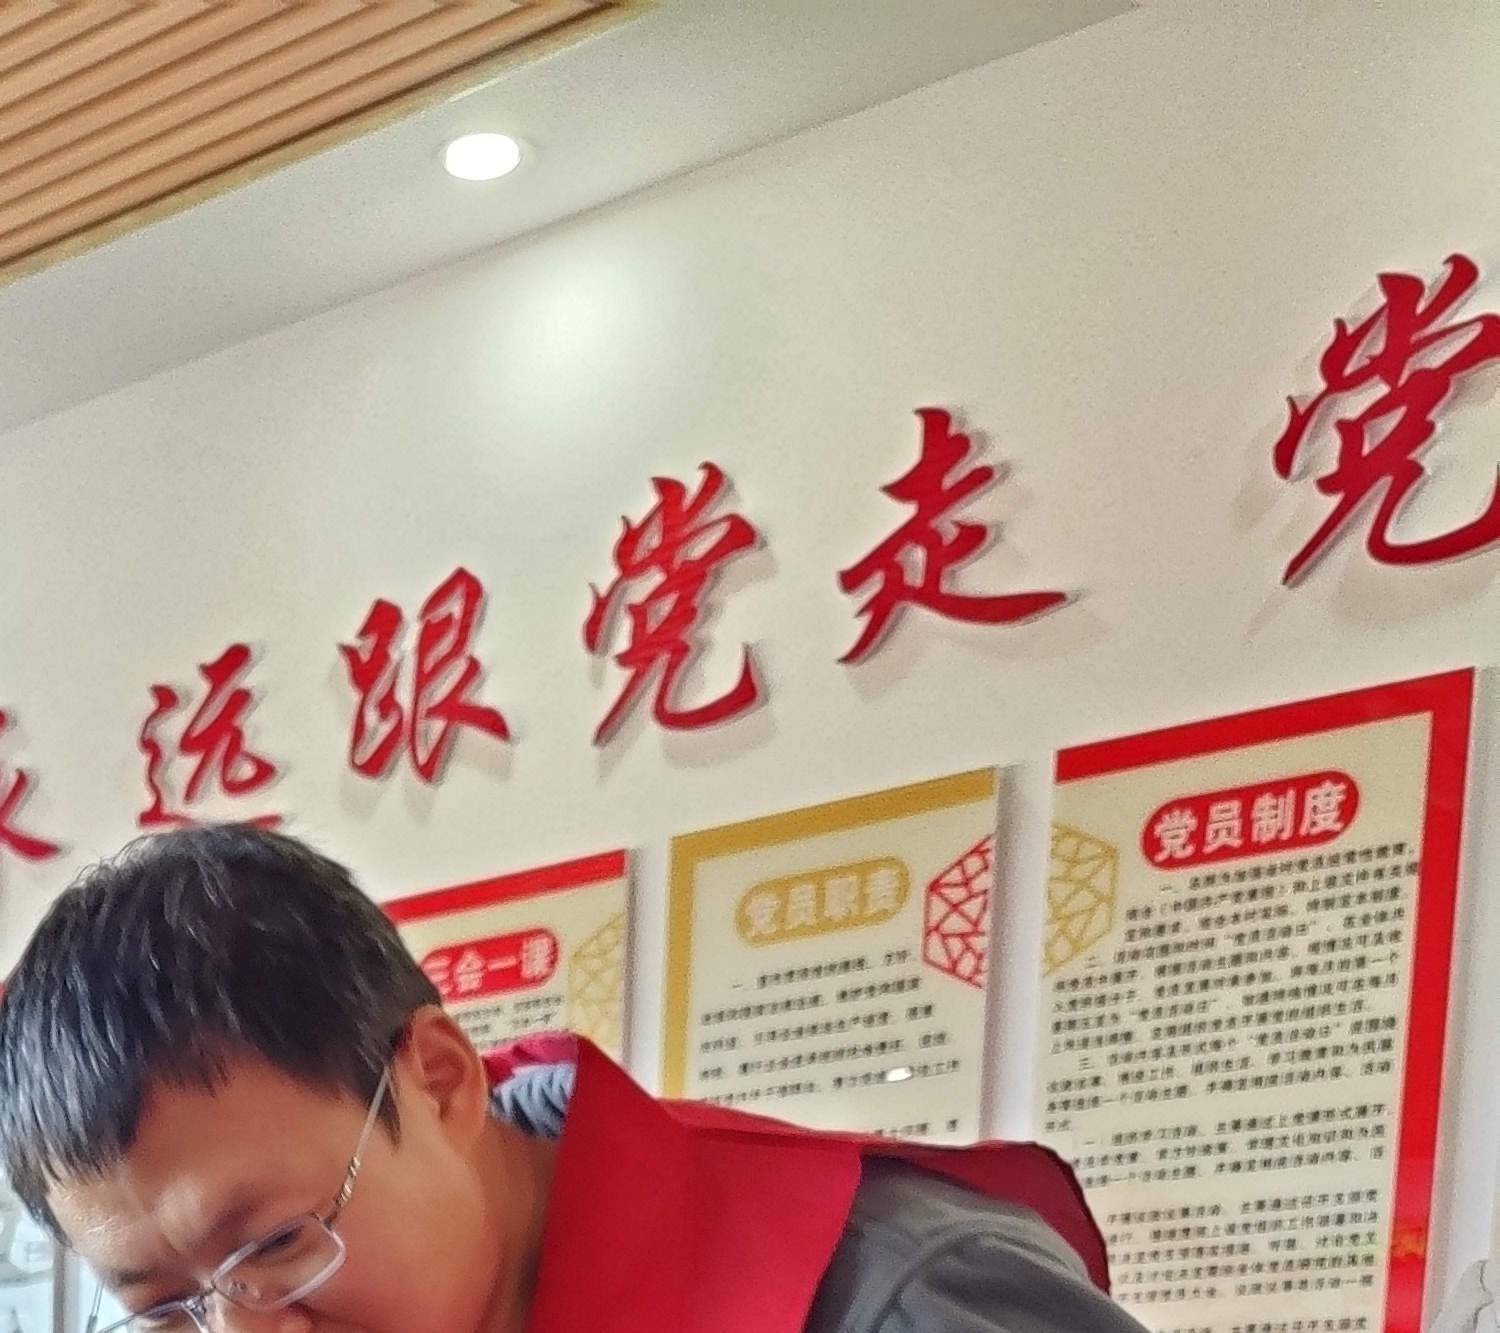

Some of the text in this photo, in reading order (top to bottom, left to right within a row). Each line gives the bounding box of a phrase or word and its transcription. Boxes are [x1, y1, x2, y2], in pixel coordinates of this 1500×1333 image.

[1273, 253, 1500, 586] 党
[1153, 780, 1348, 862] 党员制度
